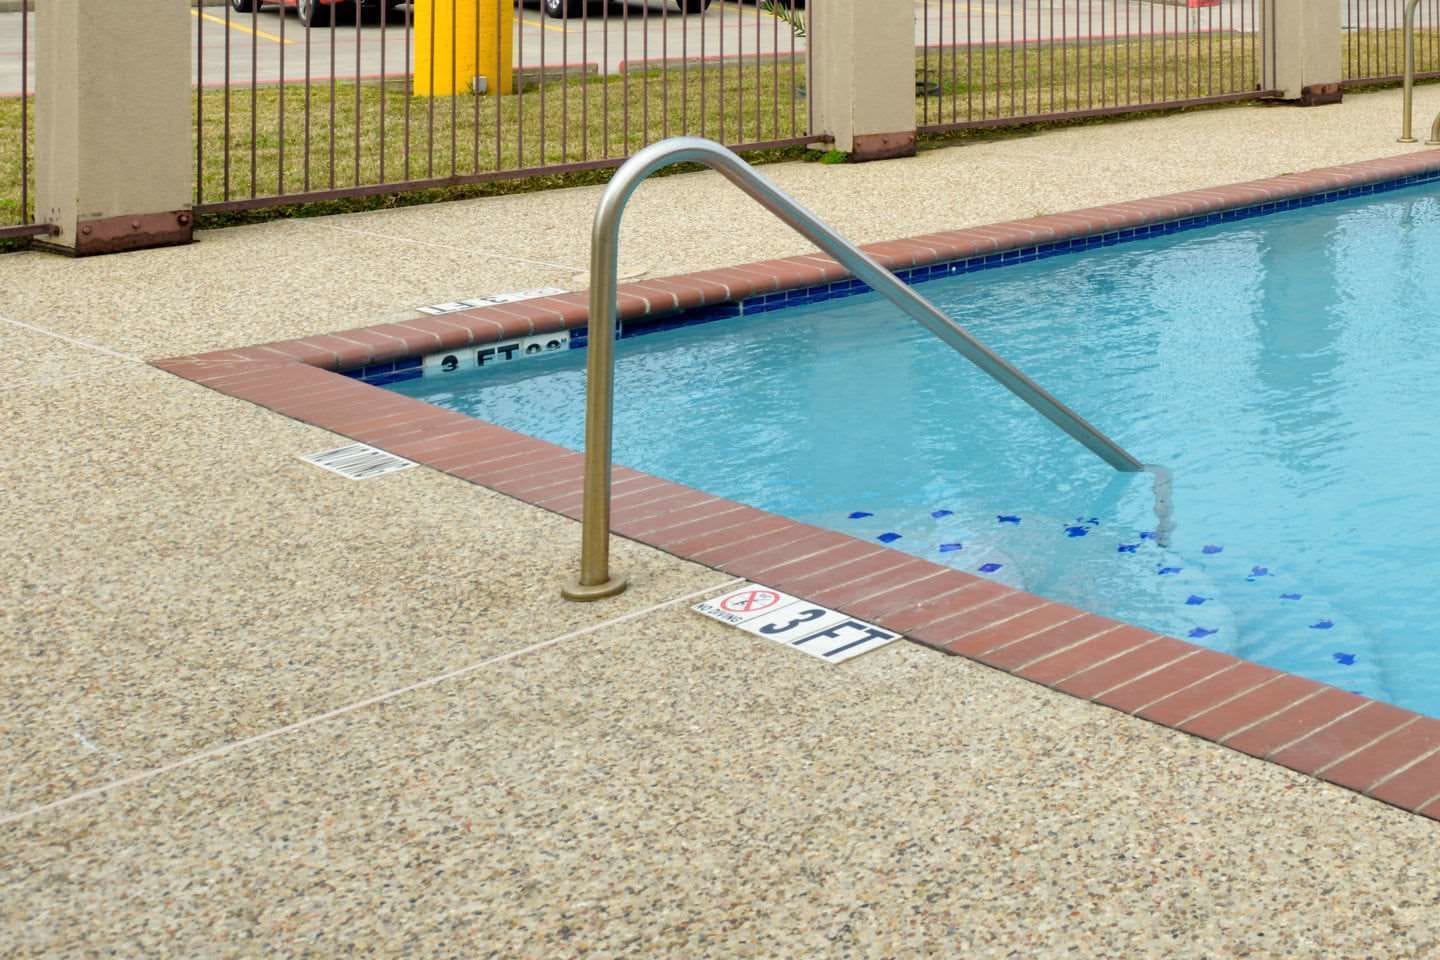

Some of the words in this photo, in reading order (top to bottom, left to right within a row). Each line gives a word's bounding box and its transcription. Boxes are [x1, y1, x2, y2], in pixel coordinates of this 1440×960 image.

[478, 343, 519, 367] FT
[759, 609, 826, 634] 3
[792, 621, 893, 658] FT
